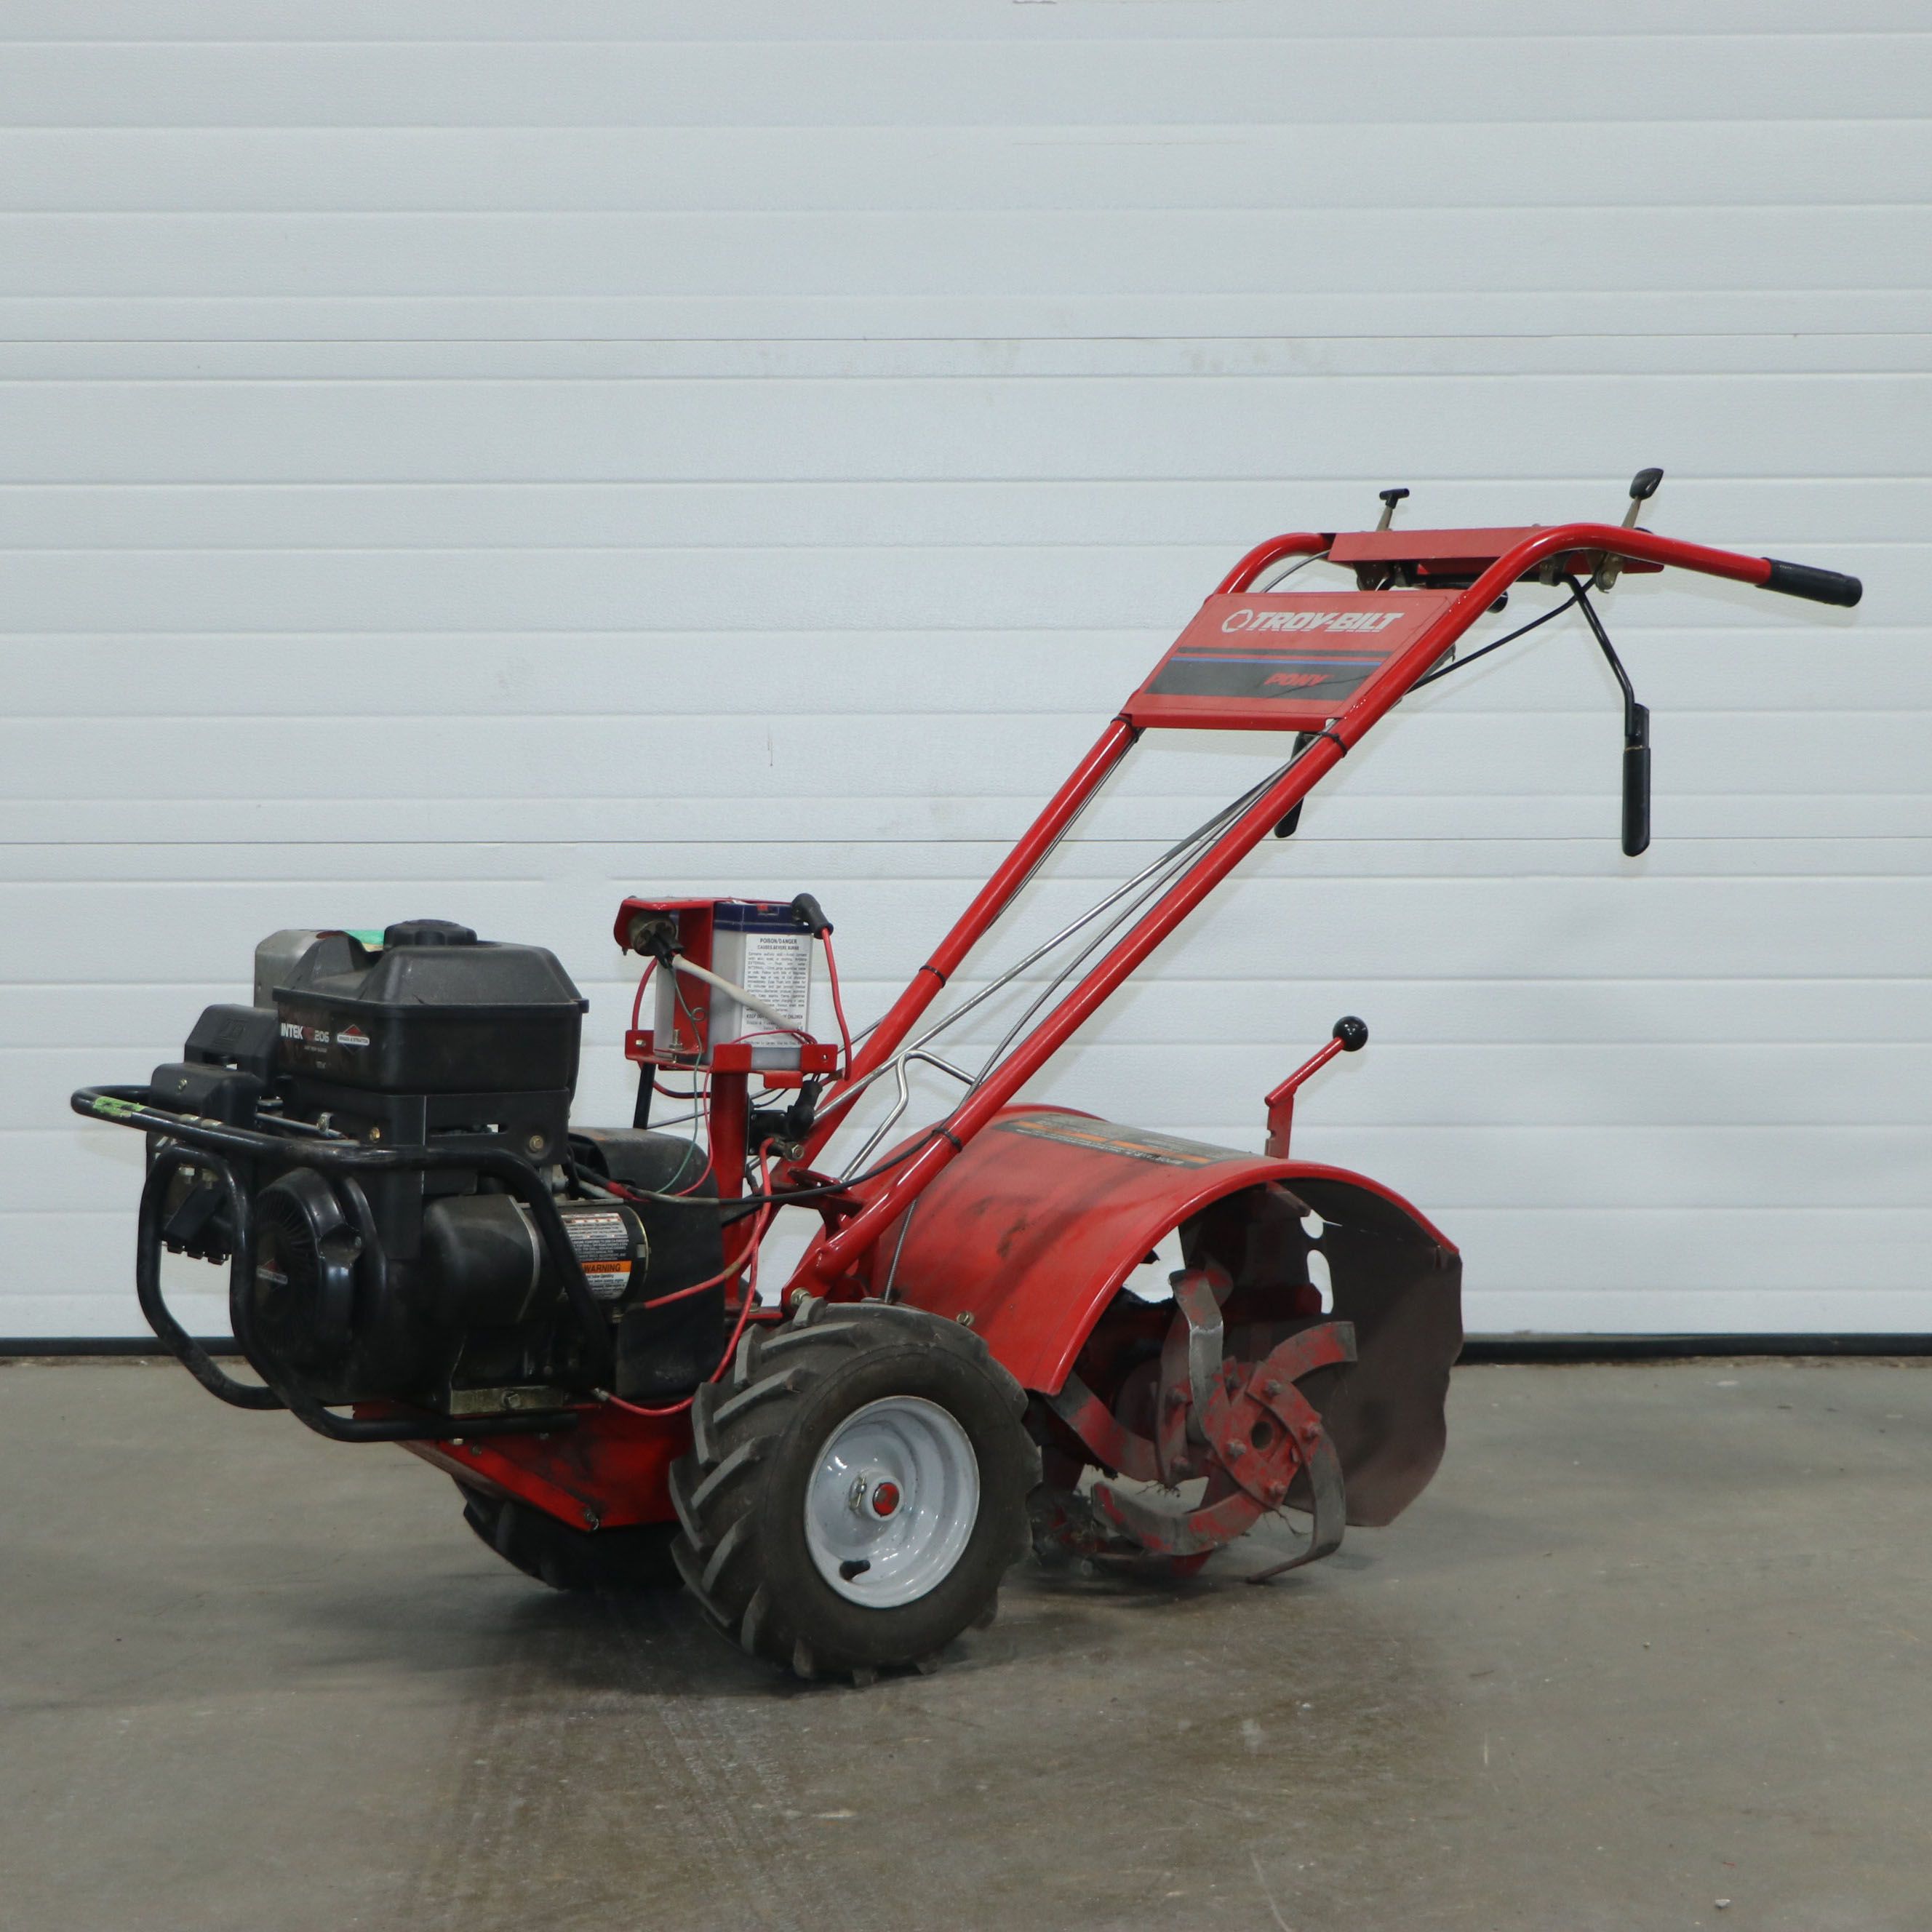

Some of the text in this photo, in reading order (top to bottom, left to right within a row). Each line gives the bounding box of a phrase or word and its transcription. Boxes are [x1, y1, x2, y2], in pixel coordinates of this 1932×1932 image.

[1245, 612, 1405, 632] TROY-BILT
[1264, 672, 1333, 687] PONY
[281, 1023, 303, 1040] INTEK
[314, 1029, 330, 1043] 206
[584, 1263, 620, 1272] WARNING
